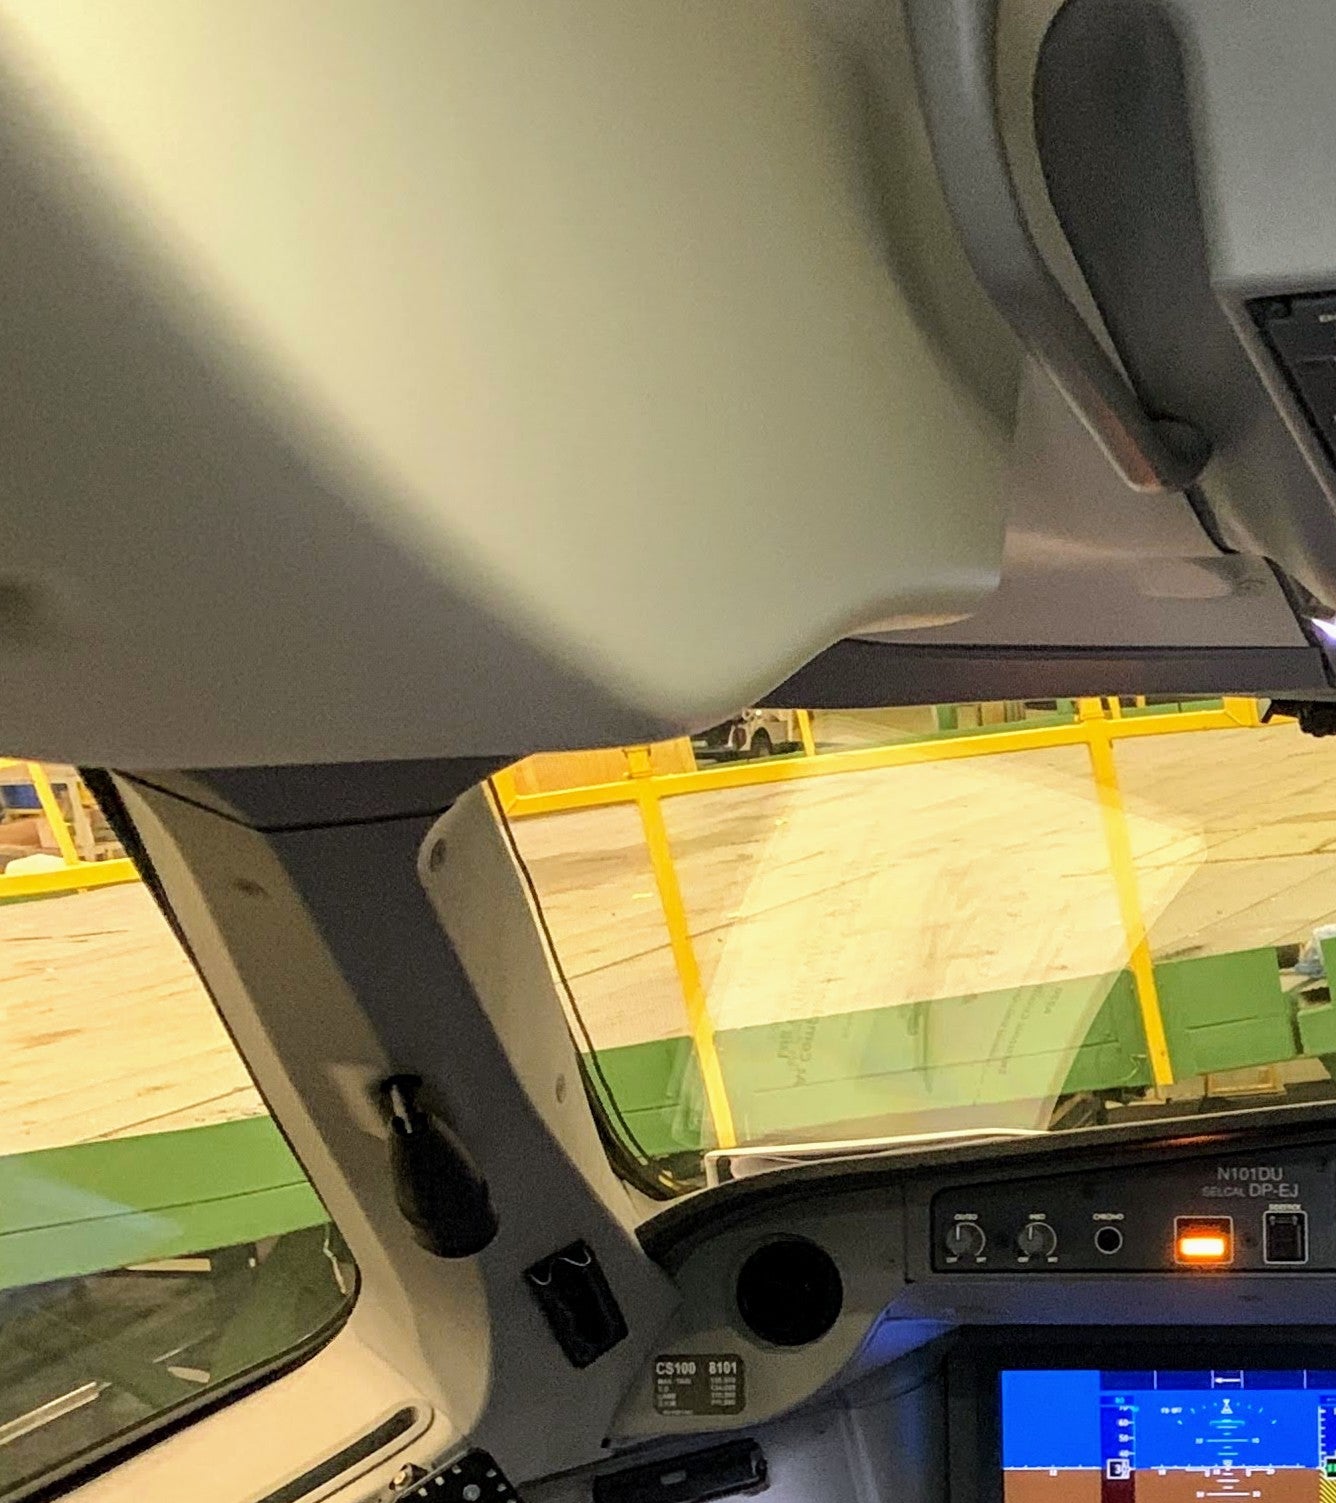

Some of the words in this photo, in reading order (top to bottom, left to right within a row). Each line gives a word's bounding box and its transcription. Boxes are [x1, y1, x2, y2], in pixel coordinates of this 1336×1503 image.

[1217, 1166, 1284, 1181] N101DU
[1250, 1183, 1299, 1198] DP-EJ
[656, 1361, 696, 1375] CS100
[709, 1361, 737, 1375] 8101
